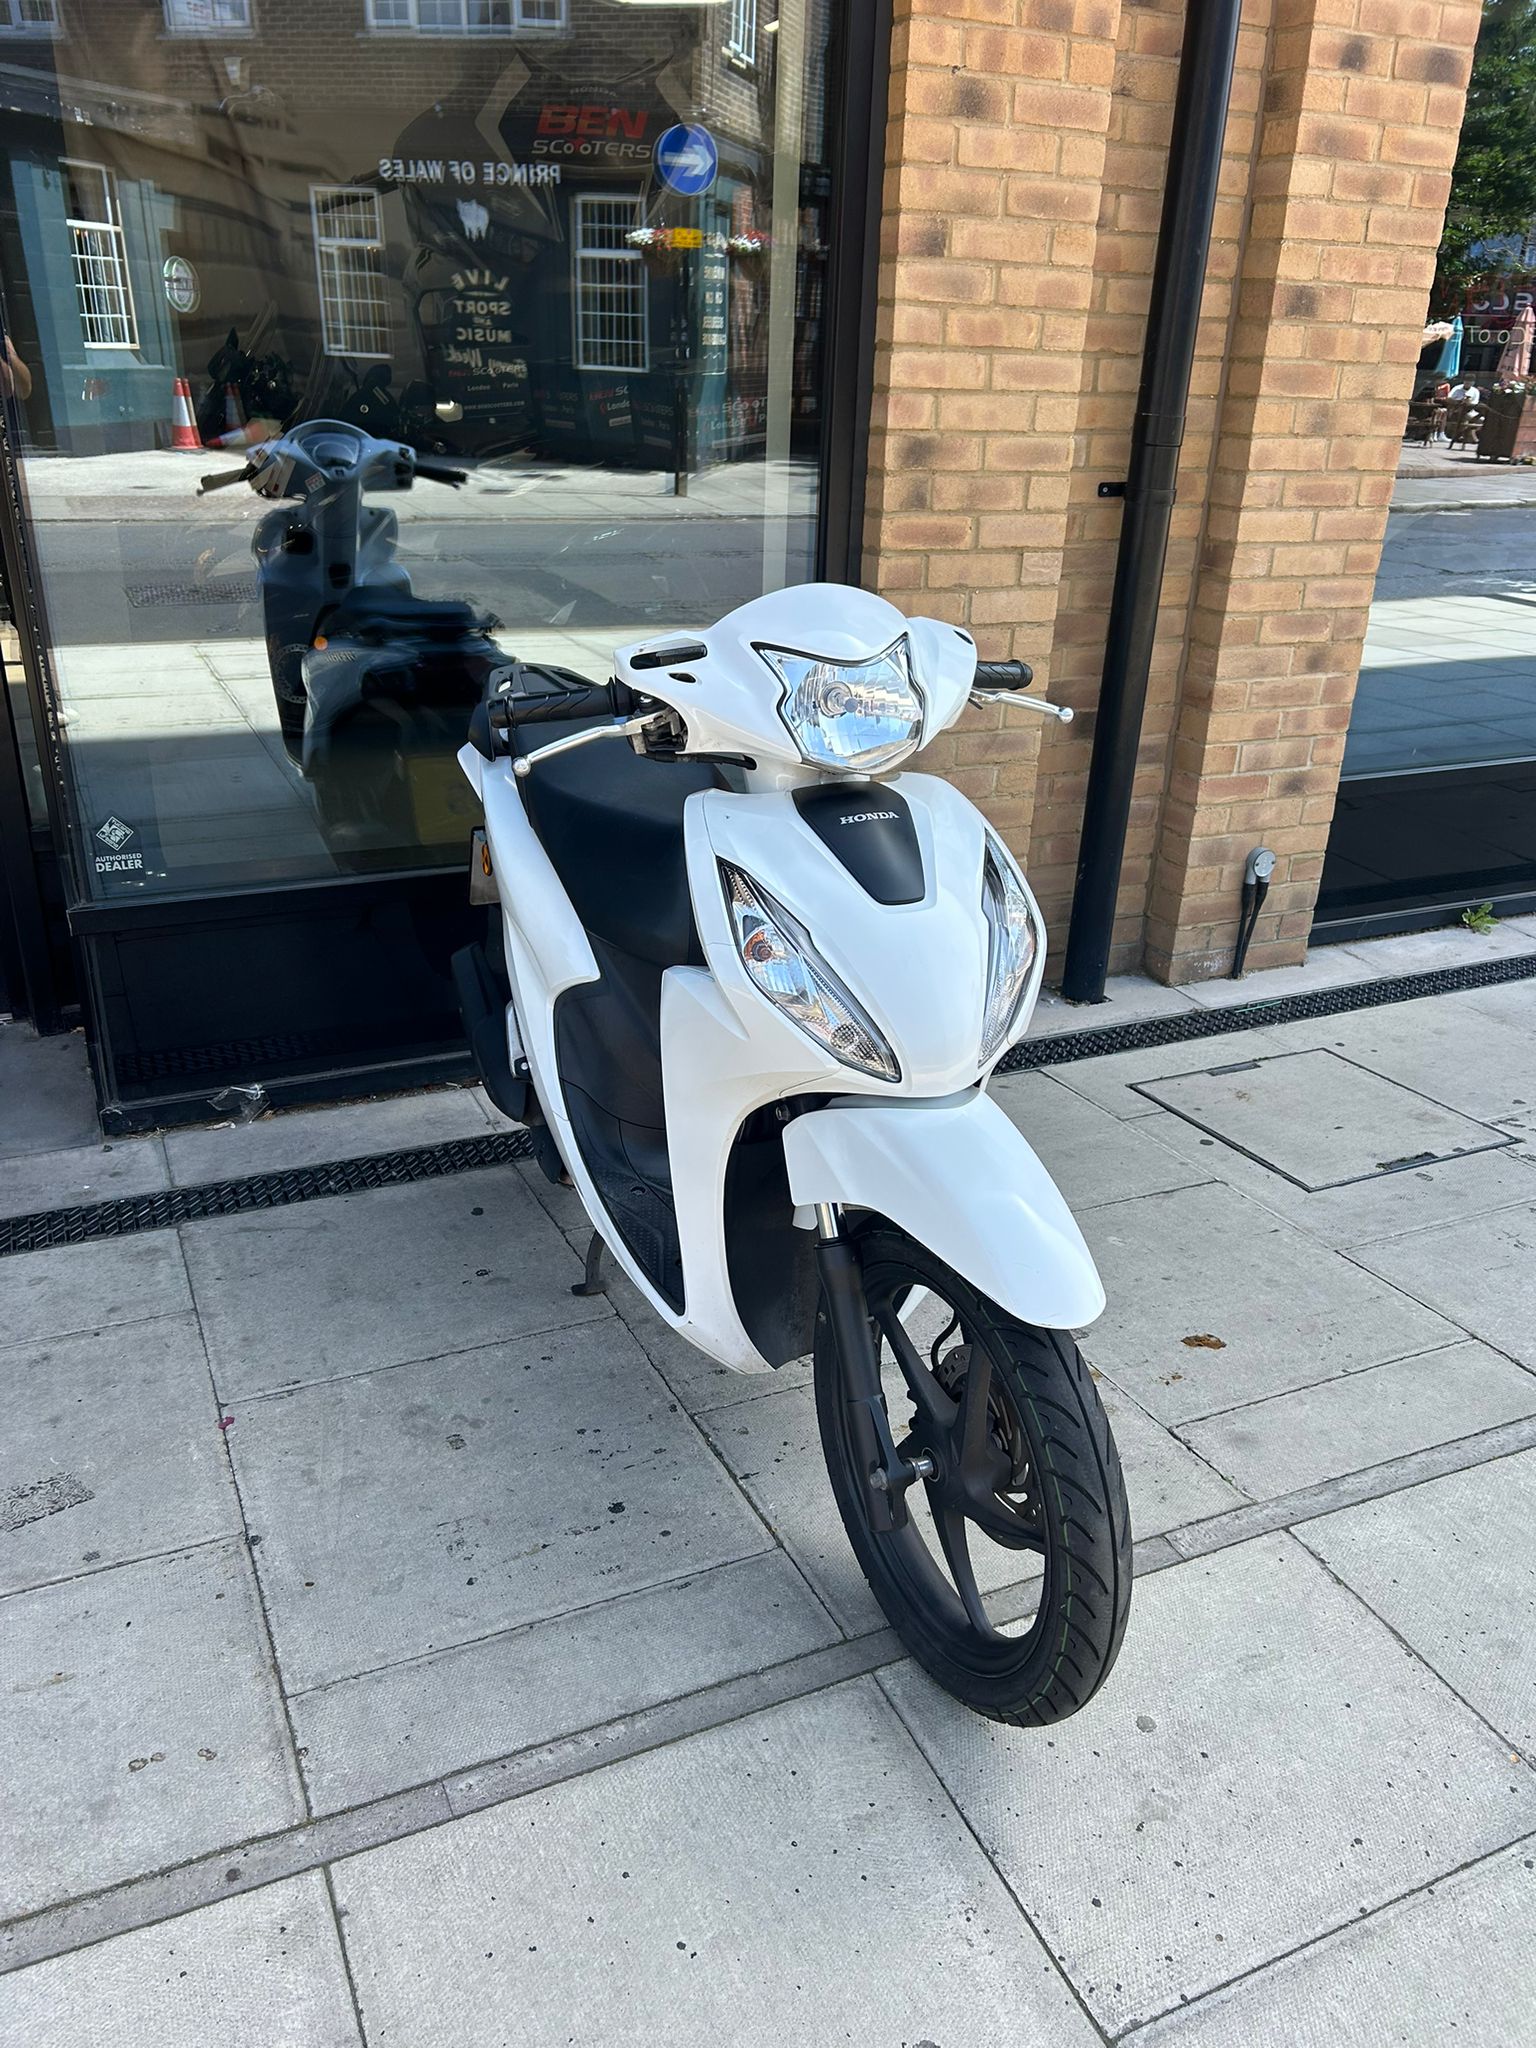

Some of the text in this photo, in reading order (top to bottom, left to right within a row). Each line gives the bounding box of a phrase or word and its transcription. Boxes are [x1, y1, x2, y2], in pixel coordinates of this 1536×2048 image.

[536, 104, 649, 139] BEN
[839, 811, 900, 825] HONDA
[95, 852, 142, 863] AUTHORISED
[95, 859, 143, 873] DEALER
